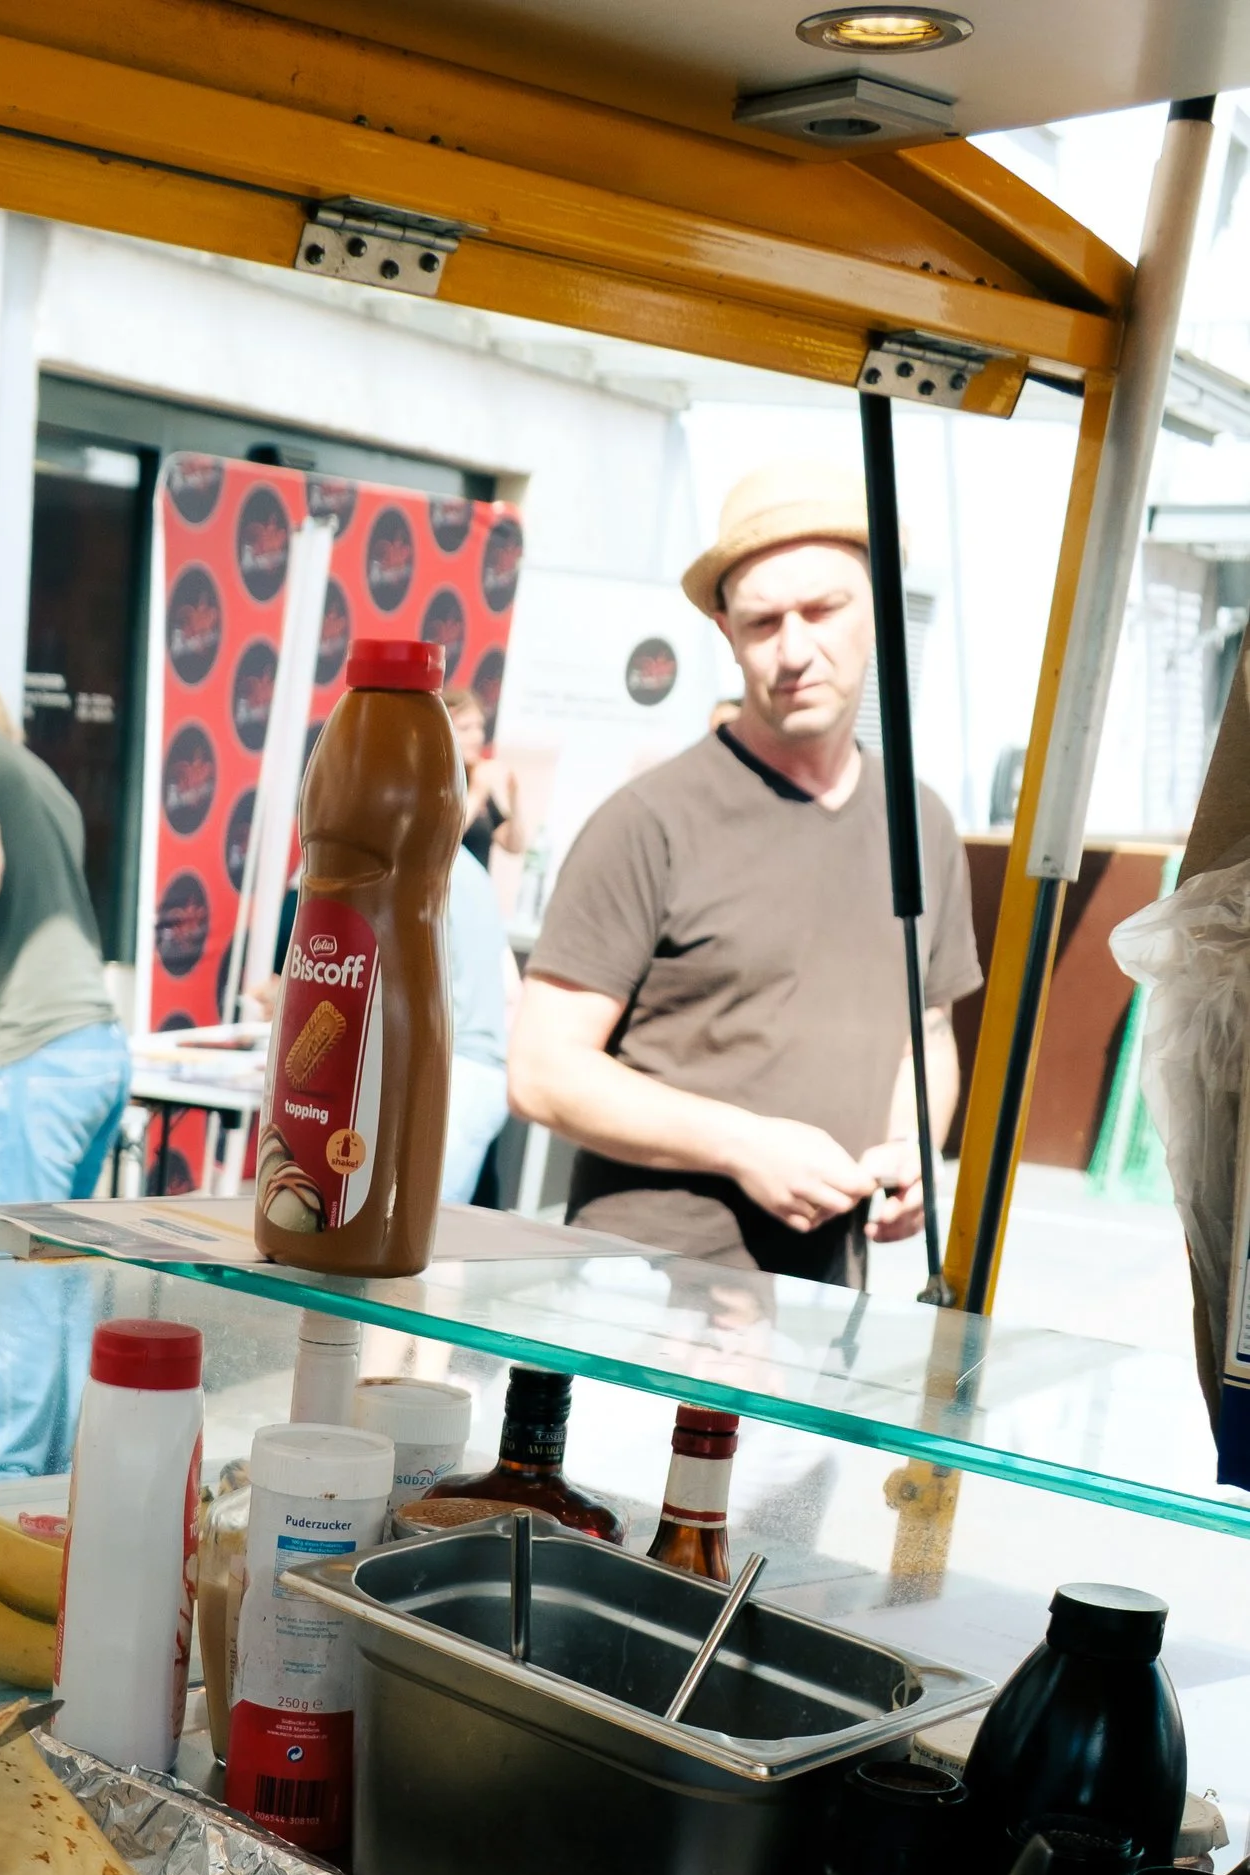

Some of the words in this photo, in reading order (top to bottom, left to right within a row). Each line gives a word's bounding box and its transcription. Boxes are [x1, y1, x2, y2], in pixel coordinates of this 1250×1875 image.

[290, 944, 366, 988] Biscoff
[285, 1099, 329, 1125] topping
[331, 1158, 359, 1169] shake!
[285, 1514, 352, 1531] Puderzucker
[278, 1696, 300, 1708] 250
